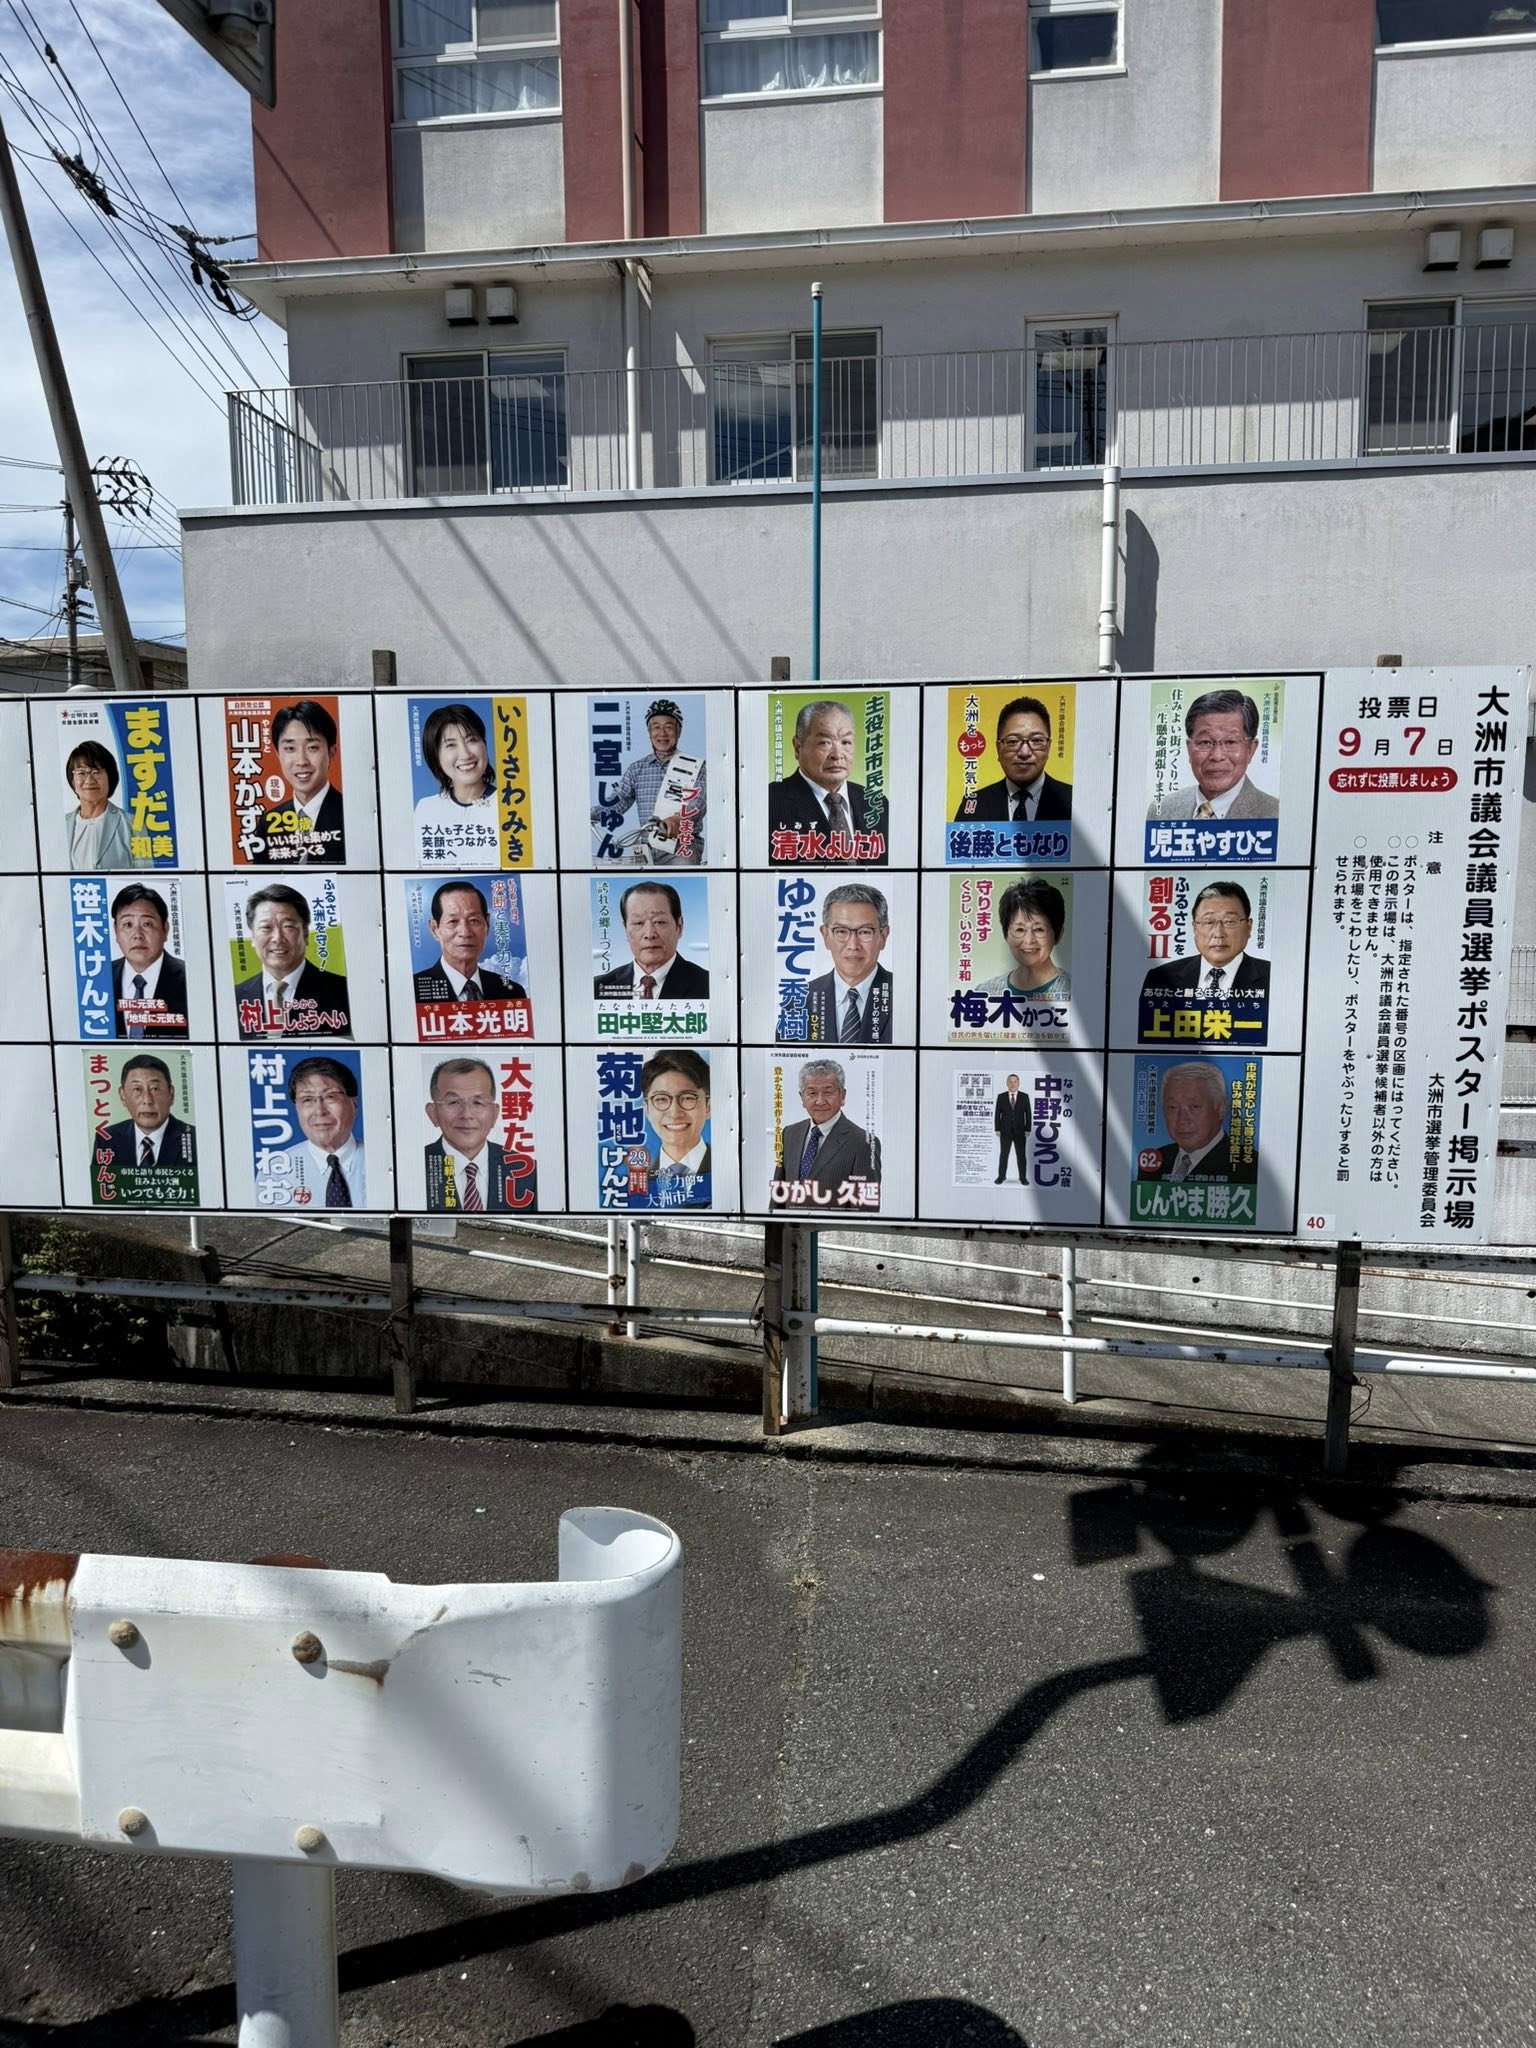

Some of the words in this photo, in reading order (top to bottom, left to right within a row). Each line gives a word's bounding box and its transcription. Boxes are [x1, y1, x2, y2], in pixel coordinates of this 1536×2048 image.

[1358, 696, 1438, 719] 投票日
[262, 719, 271, 753] やまもと
[1169, 688, 1183, 791] 住みよい街づくりに
[864, 695, 885, 829] 主役は市民です
[230, 718, 266, 860] 山本かずや
[497, 705, 527, 862] いりさわみき
[592, 702, 624, 858] 二宮じゅん
[1337, 773, 1451, 788] 忘れずに投票しましょう
[265, 810, 312, 833] 29歳
[421, 824, 495, 836] 大人も子どもも
[779, 821, 818, 829] しみず
[268, 844, 326, 860] 未来をつくる
[422, 836, 498, 848] 笑顔でつながる
[423, 848, 457, 860] 未来へ
[771, 830, 885, 860] 清水よしたか
[950, 829, 1069, 860] 後藤ともなり
[1150, 828, 1273, 858] 児玉やすひこ
[1425, 831, 1444, 875] 注意
[324, 879, 338, 928] ふるさと
[1333, 856, 1348, 930] せられます。
[1365, 855, 1383, 958] 使用できません。
[976, 880, 993, 942] 守ります
[1174, 877, 1190, 955] ふるさとを
[72, 882, 110, 1036] 笹木けんご
[777, 878, 816, 1040] ゆだて秀樹
[1443, 685, 1510, 1230] 大洲市議会議員選挙ポスター掲示場
[598, 1003, 705, 1011] たなかけんたろう
[1144, 987, 1265, 999] あなたと創る住みよい大洲
[240, 999, 347, 1033] 村上しょうへい
[421, 1008, 528, 1037] 山本光明
[597, 1012, 708, 1035] 田中堅太郎
[1143, 1008, 1262, 1040] 上田栄一
[1063, 1078, 1073, 1118] なかの
[250, 1054, 293, 1206] 村上つねお
[500, 1057, 535, 1208] 大野たつし
[597, 1052, 645, 1207] 菊地けんた
[1033, 1074, 1062, 1187] 中野ひろし
[1420, 1073, 1445, 1228] 大洲市選挙管理委員会
[769, 1180, 832, 1205] ひがし
[837, 1181, 880, 1205] 久延
[1136, 1184, 1254, 1219] しんやま勝久
[1307, 1217, 1325, 1229] 40
